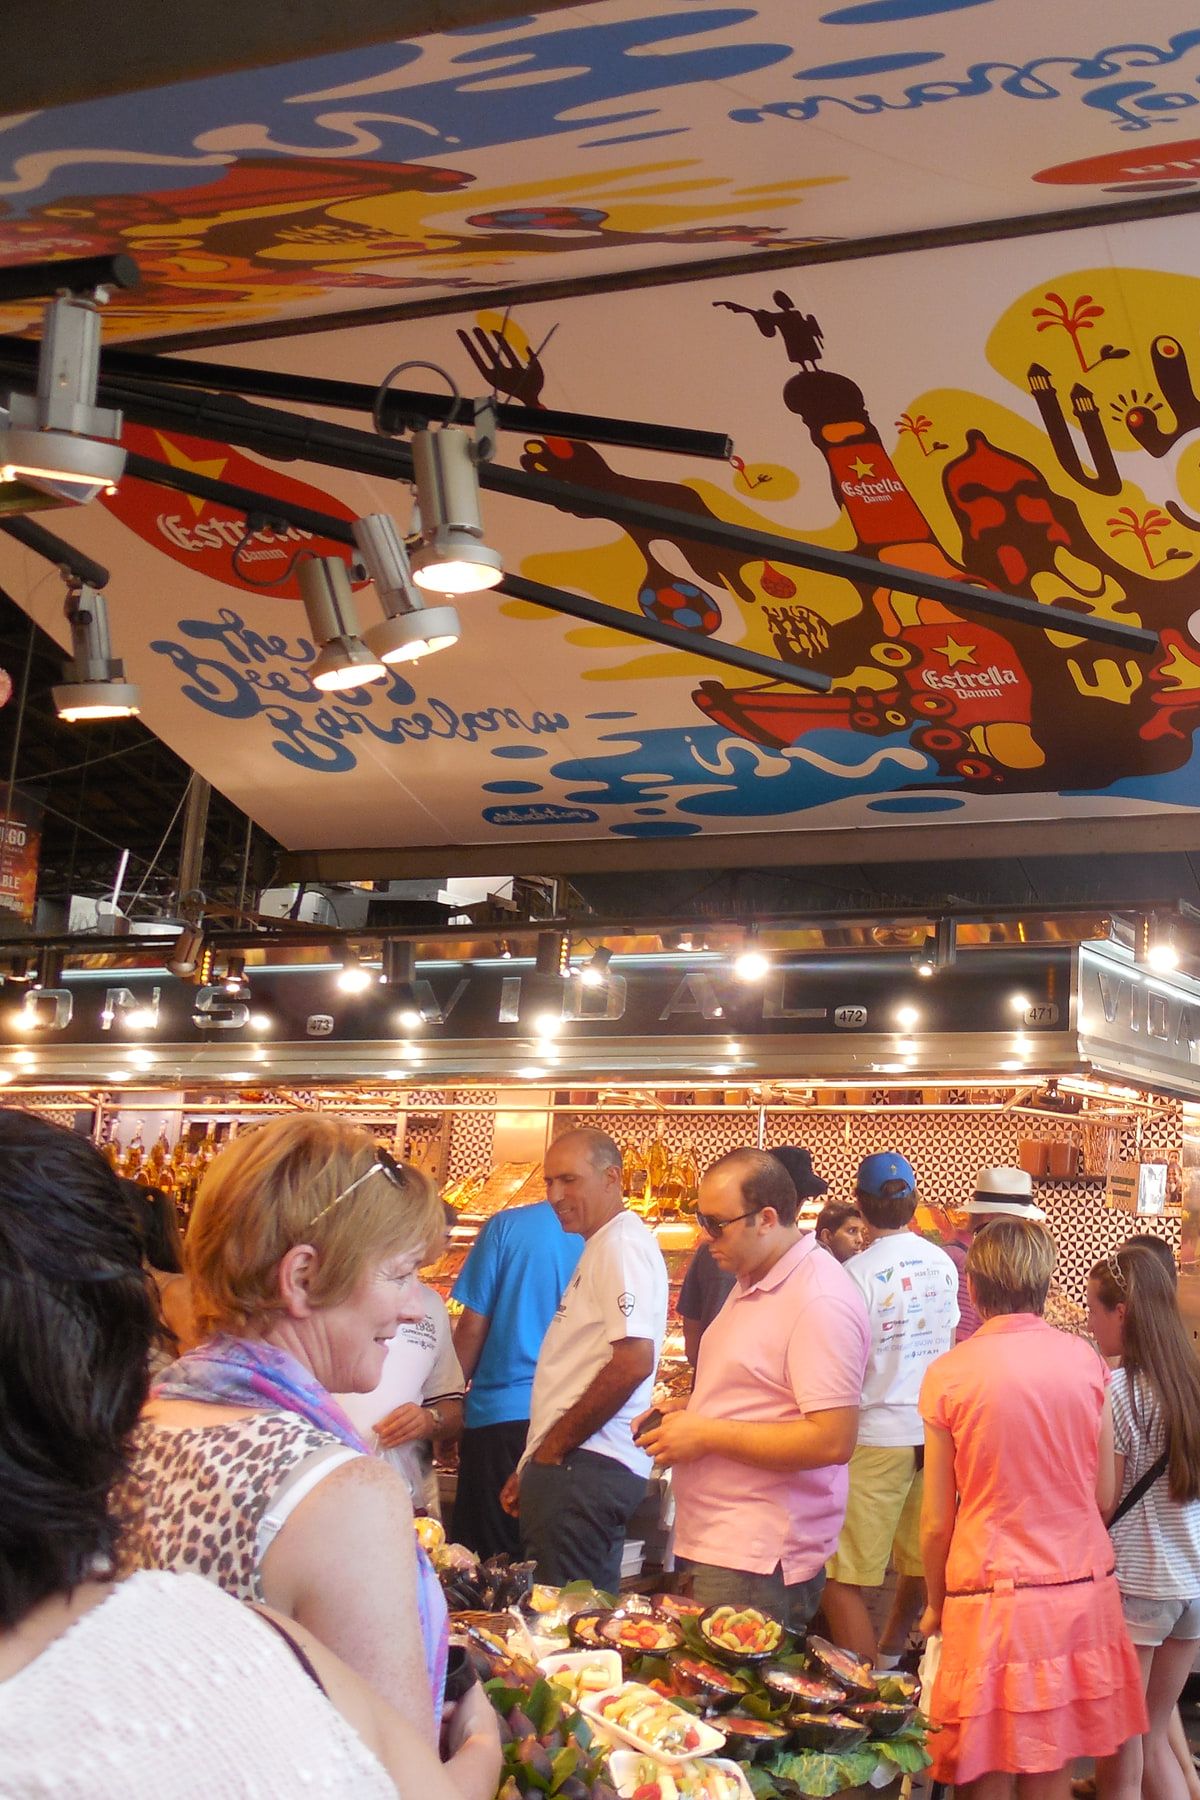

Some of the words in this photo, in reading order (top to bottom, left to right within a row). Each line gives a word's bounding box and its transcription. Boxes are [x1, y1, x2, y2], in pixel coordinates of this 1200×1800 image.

[840, 475, 904, 499] Estrella
[862, 493, 893, 504] Damm
[177, 607, 317, 664] The
[921, 665, 1020, 692] Estrella
[953, 684, 1003, 700] Damm
[260, 697, 570, 773] Barcelona
[409, 971, 828, 1025] VIDAL
[838, 1008, 865, 1024] 472
[1028, 1004, 1055, 1021] 471
[308, 1018, 331, 1032] 473
